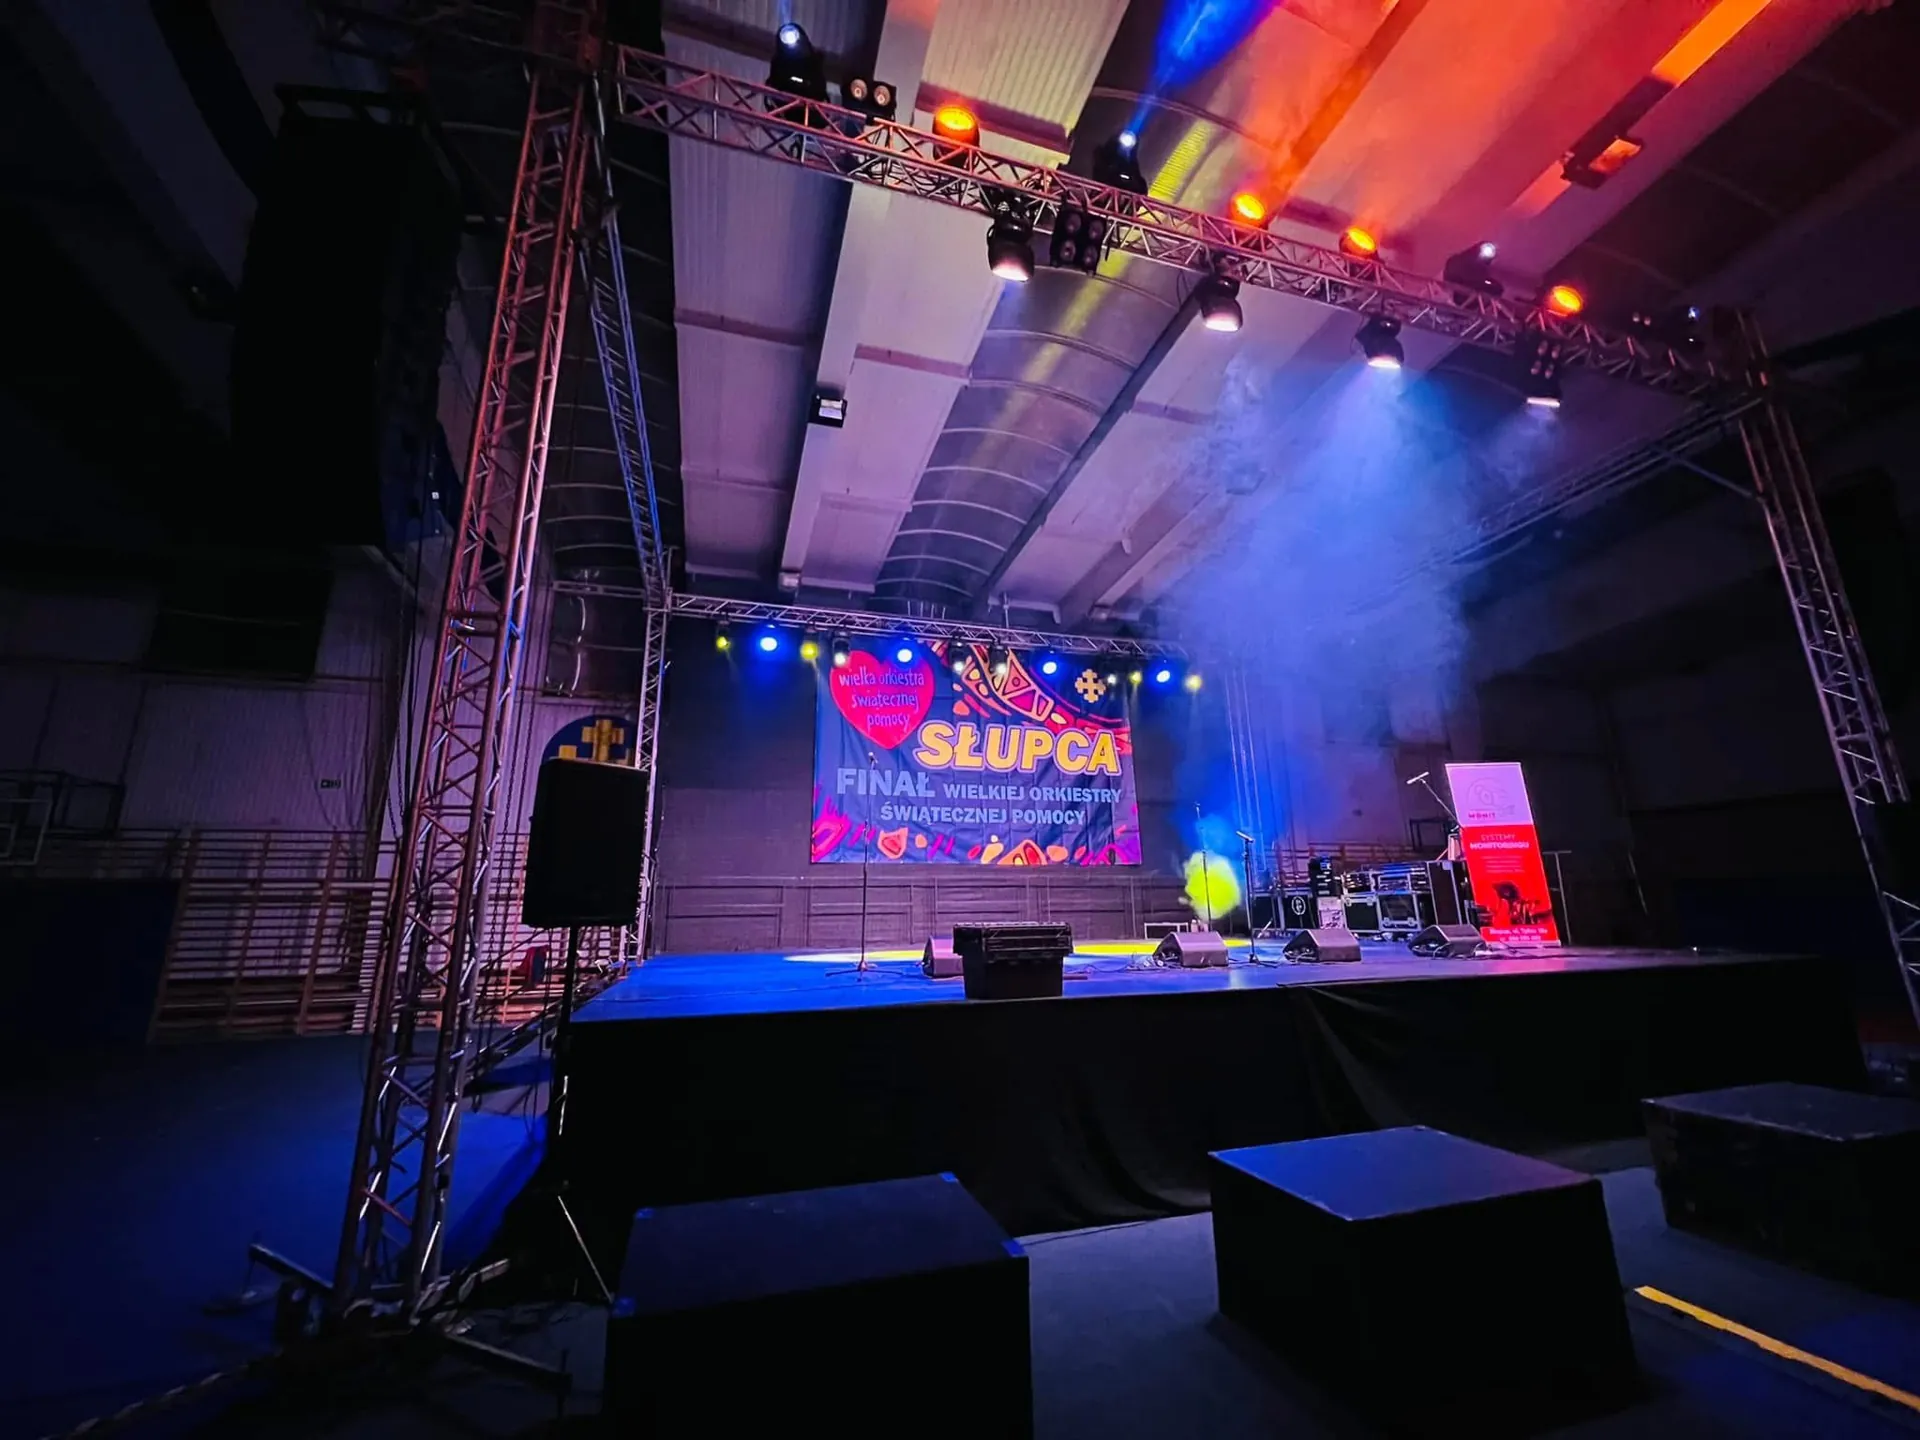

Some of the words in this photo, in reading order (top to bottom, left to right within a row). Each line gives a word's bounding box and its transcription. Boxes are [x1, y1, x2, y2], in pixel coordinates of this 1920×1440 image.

[839, 666, 876, 687] wielka
[878, 668, 925, 687] orkiestra
[851, 688, 919, 714] świątecznej
[867, 713, 910, 732] pomocy
[914, 721, 1121, 774] SŁUPCA
[837, 768, 935, 797] FINAŁ
[943, 783, 1025, 800] WIELKIEJ
[1030, 786, 1122, 803] ORKIESTRY
[880, 801, 1007, 825] ŚWIĄTECZNEJ
[1012, 809, 1086, 825] POMOCY
[1480, 833, 1516, 842] SYSTEMY
